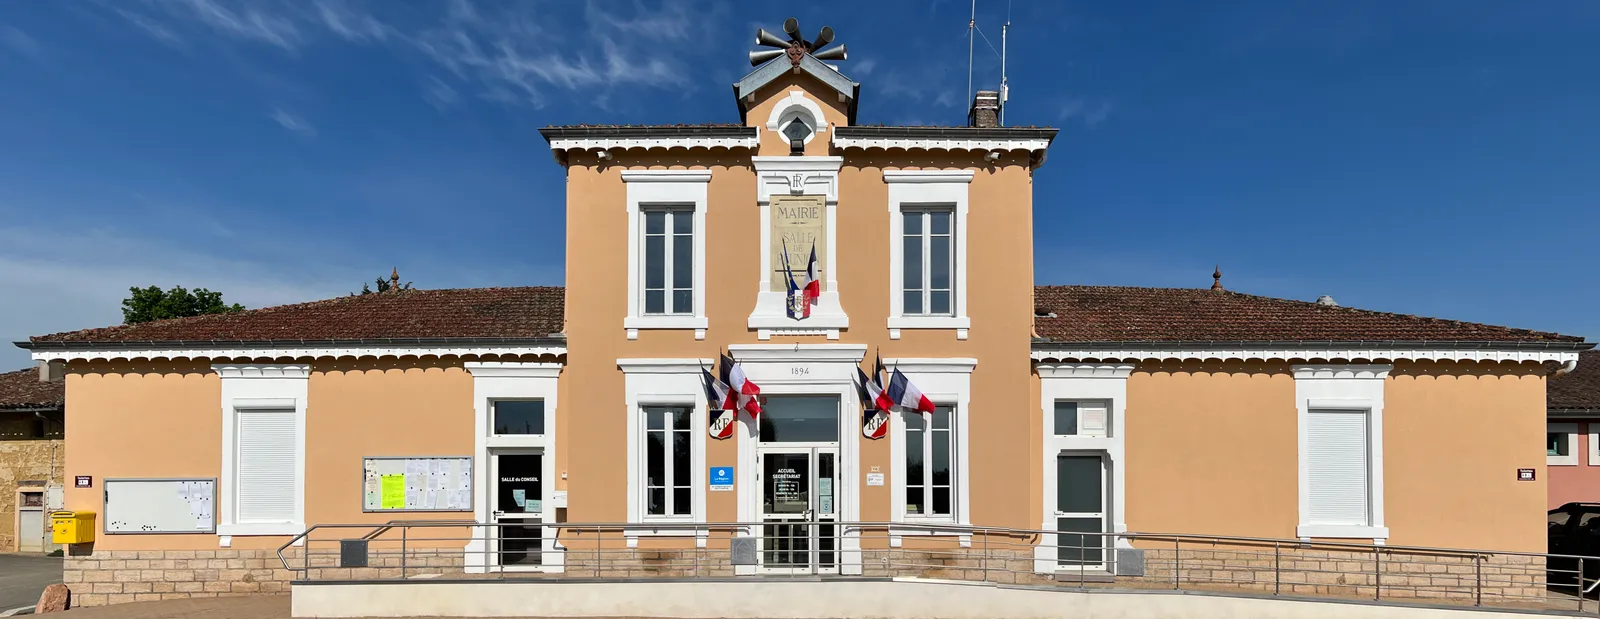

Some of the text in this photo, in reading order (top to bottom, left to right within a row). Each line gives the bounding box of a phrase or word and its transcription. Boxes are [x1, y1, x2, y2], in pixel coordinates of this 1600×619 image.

[777, 207, 818, 219] MAIRIE
[783, 232, 813, 244] SALLE
[791, 368, 809, 376] 1894
[714, 418, 730, 430] RF
[868, 418, 884, 430] RF
